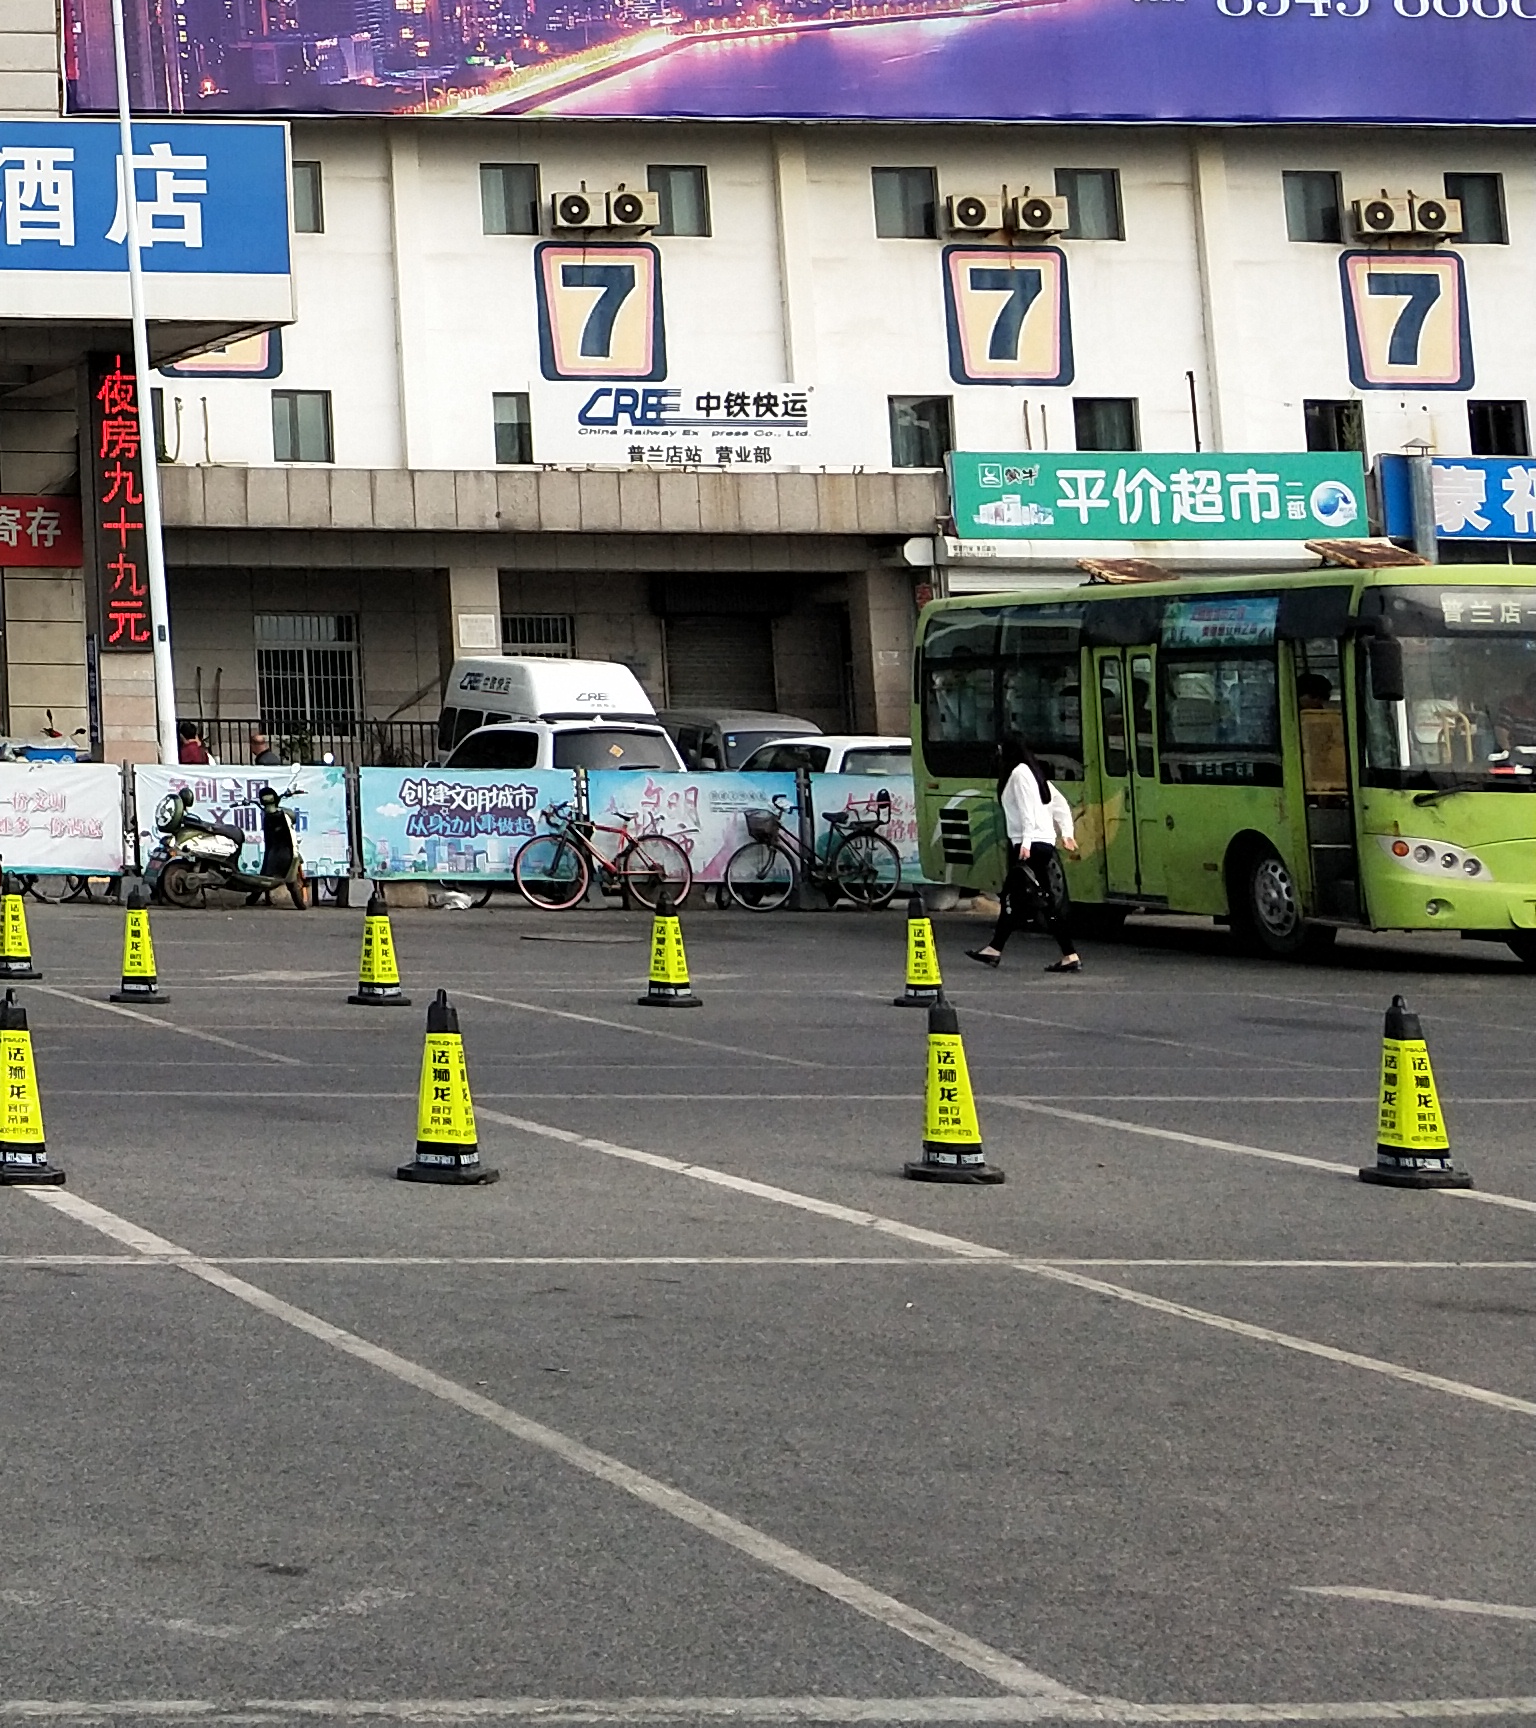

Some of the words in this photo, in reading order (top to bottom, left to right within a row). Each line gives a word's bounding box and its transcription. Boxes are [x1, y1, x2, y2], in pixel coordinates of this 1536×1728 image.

[561, 263, 636, 359] 7
[969, 268, 1043, 362] 7
[1366, 272, 1442, 366] 7
[695, 391, 809, 419] 中铁快运
[627, 445, 703, 464] 普兰店站
[715, 445, 772, 464] 营业部
[1055, 467, 1281, 525] 平价超市
[402, 778, 537, 810] 创建文明城市
